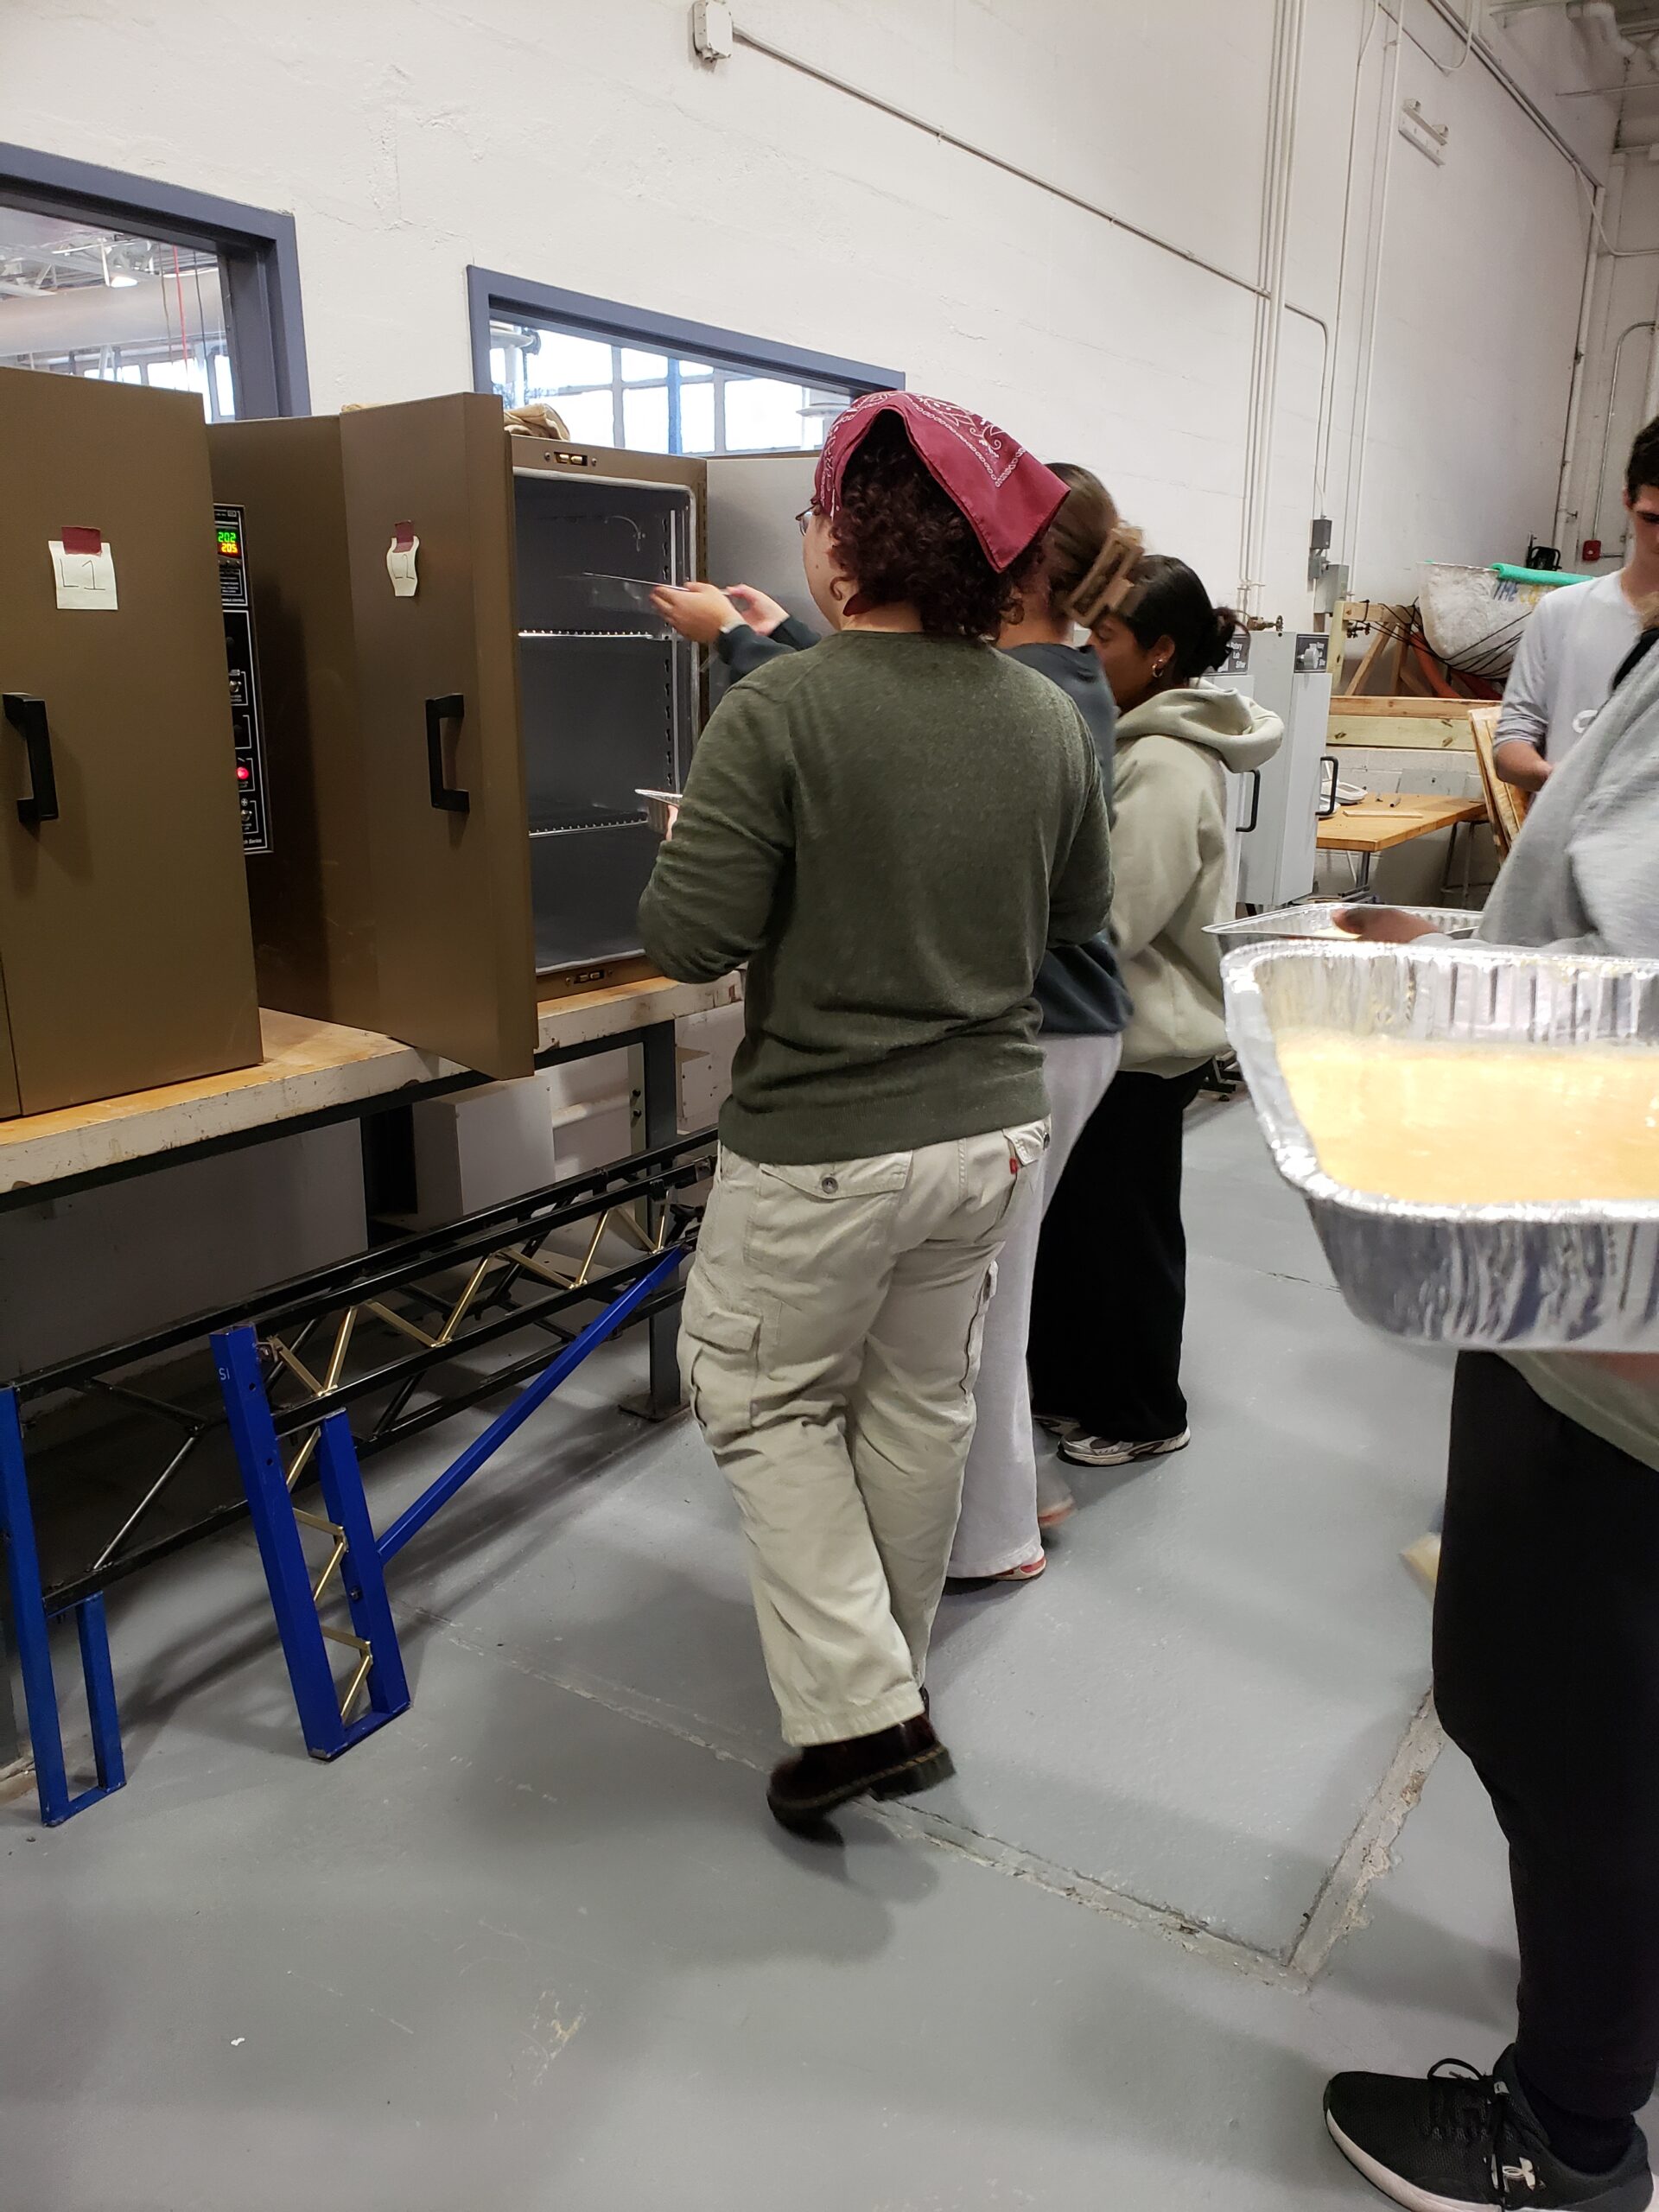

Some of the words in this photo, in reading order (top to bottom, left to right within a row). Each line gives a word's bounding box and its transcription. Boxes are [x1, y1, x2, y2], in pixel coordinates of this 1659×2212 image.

[218, 531, 237, 543] 202
[221, 543, 238, 553] 205
[59, 558, 106, 591] L1
